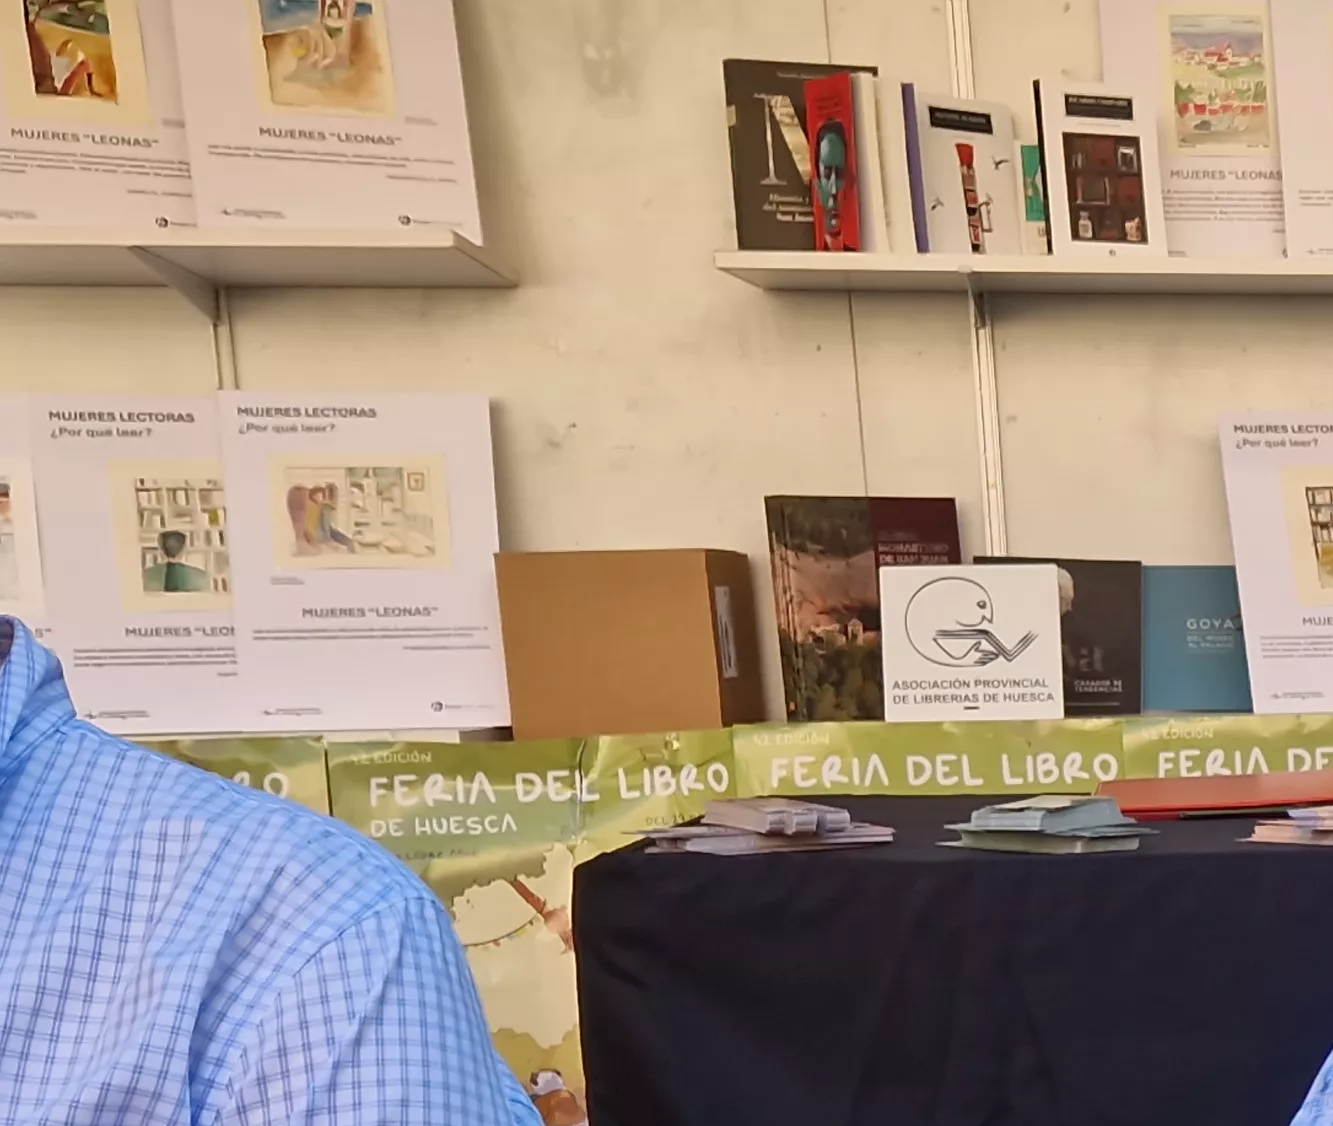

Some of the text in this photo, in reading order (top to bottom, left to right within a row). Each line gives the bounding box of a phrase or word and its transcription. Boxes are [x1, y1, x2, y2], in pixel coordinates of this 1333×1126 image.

[10, 127, 80, 142] MUJERES
[259, 127, 326, 141] MUJERES
[1170, 169, 1226, 180] MUJERES
[49, 411, 195, 424] MUJERES LECTORAS
[236, 406, 377, 419] MUJERES LECTORAS
[1233, 424, 1288, 434] MUJERES
[302, 606, 366, 618] MUJERES
[1187, 618, 1234, 630] GOYA
[124, 626, 192, 637] MUJERES
[892, 678, 1049, 690] ASOCIACIÓN PROVINCIAL
[893, 694, 909, 705] DE
[983, 692, 999, 703] DE
[1003, 691, 1055, 703] HUESCA
[1158, 746, 1270, 779] FERIA
[770, 751, 1119, 790] FERIA DEL LIBRO
[369, 762, 729, 808] FERIA DEL LIBRO
[370, 813, 518, 838] DE HUESCA
